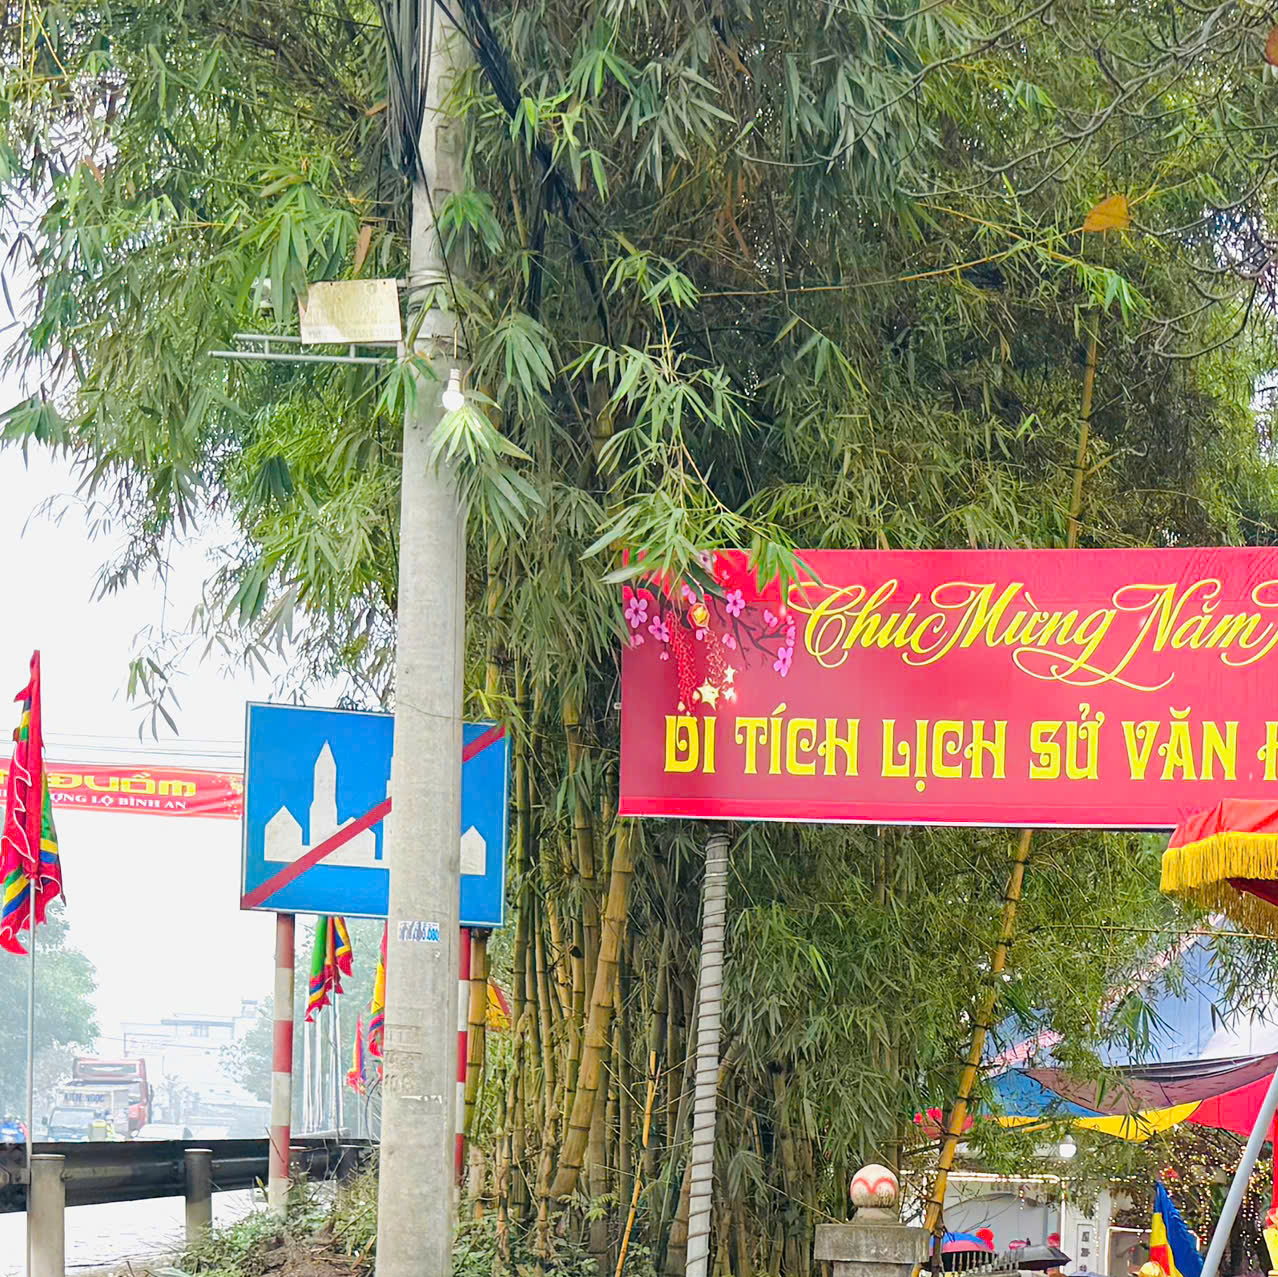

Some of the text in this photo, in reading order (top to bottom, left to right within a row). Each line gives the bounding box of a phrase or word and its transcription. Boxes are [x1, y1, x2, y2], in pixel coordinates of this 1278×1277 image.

[787, 579, 947, 668] Chúc
[902, 582, 1174, 691] Mừng
[1050, 578, 1273, 686] Năm
[664, 715, 717, 773] DI
[735, 702, 860, 777] TÍCH
[881, 719, 1008, 793] LỊCH
[1029, 703, 1106, 780] SỬ
[1121, 706, 1239, 781] VĂN
